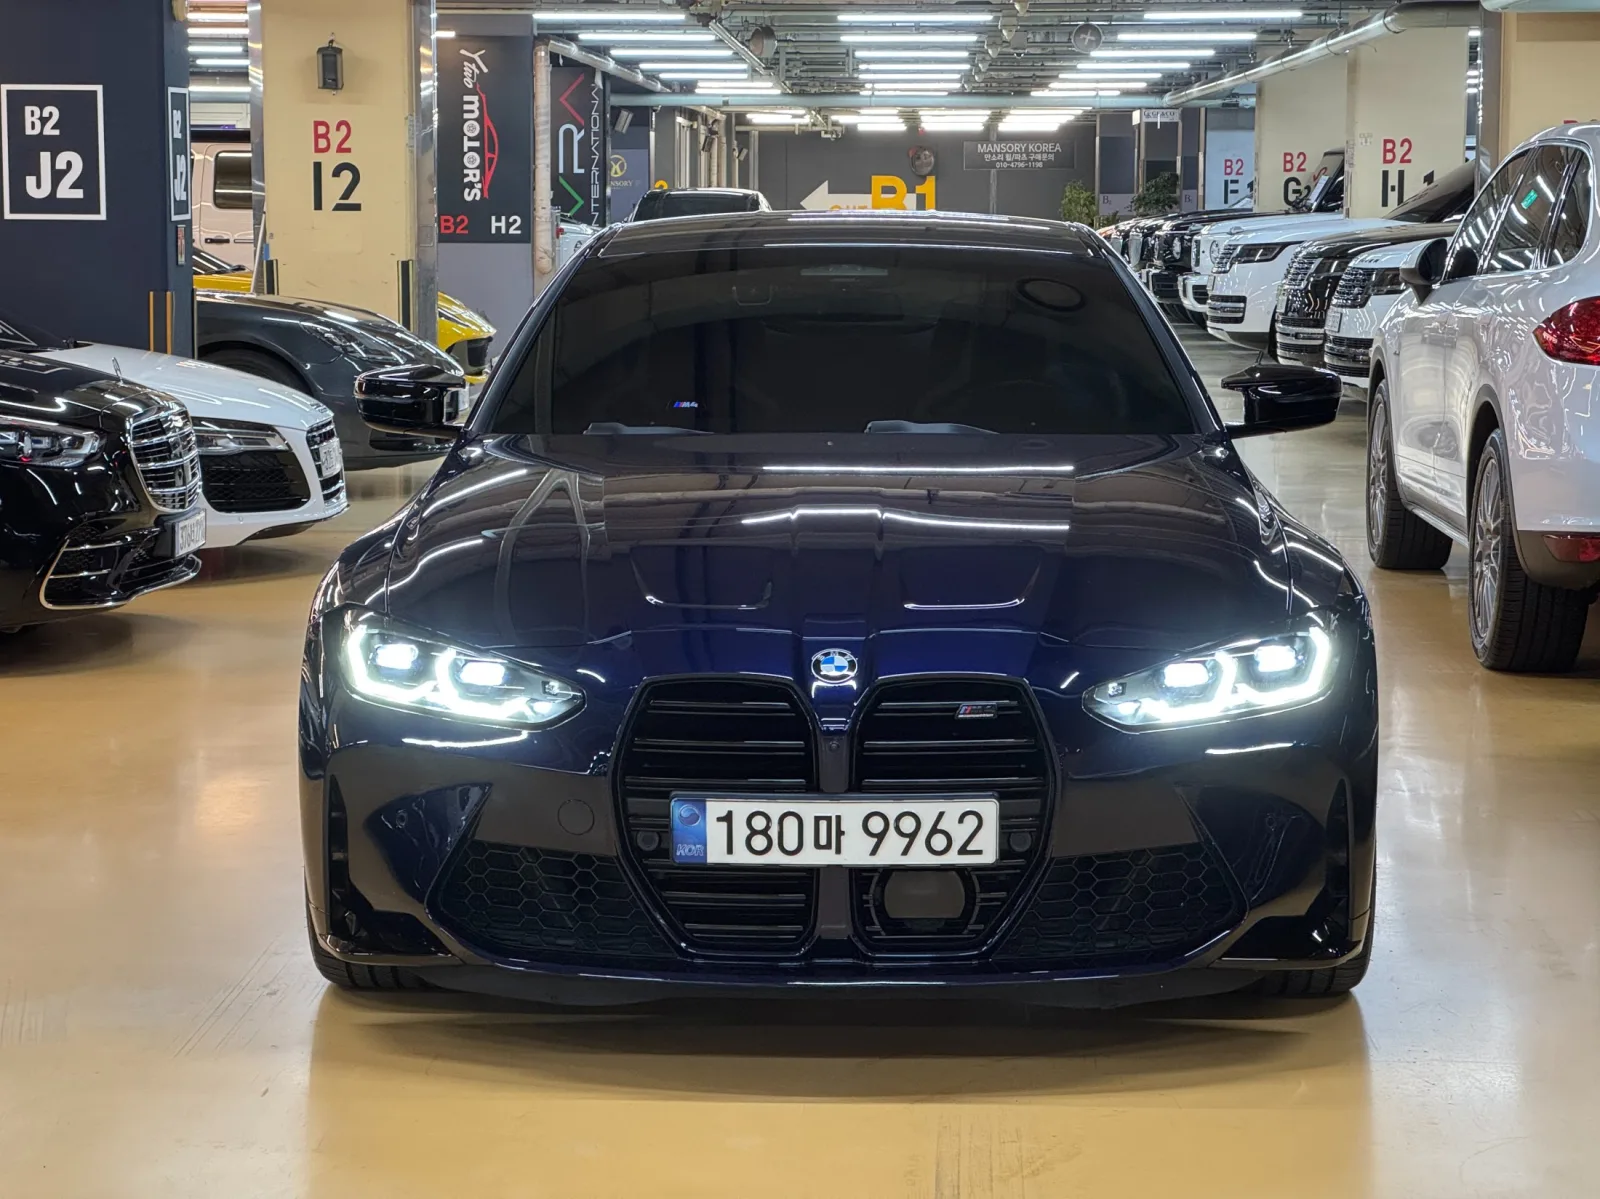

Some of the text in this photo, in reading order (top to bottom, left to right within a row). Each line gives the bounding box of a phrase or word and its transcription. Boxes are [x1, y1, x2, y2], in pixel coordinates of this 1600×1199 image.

[24, 105, 60, 136] B2
[312, 119, 353, 154] B2
[977, 142, 1062, 153] MANSORY KOREA
[1283, 151, 1307, 172] B2
[1382, 137, 1413, 164] B2
[25, 150, 84, 200] J2
[1224, 158, 1244, 176] B2
[312, 160, 362, 212] I2
[439, 215, 522, 235] B2 H2
[715, 809, 984, 856] 180마 9962
[676, 843, 705, 857] KOR
